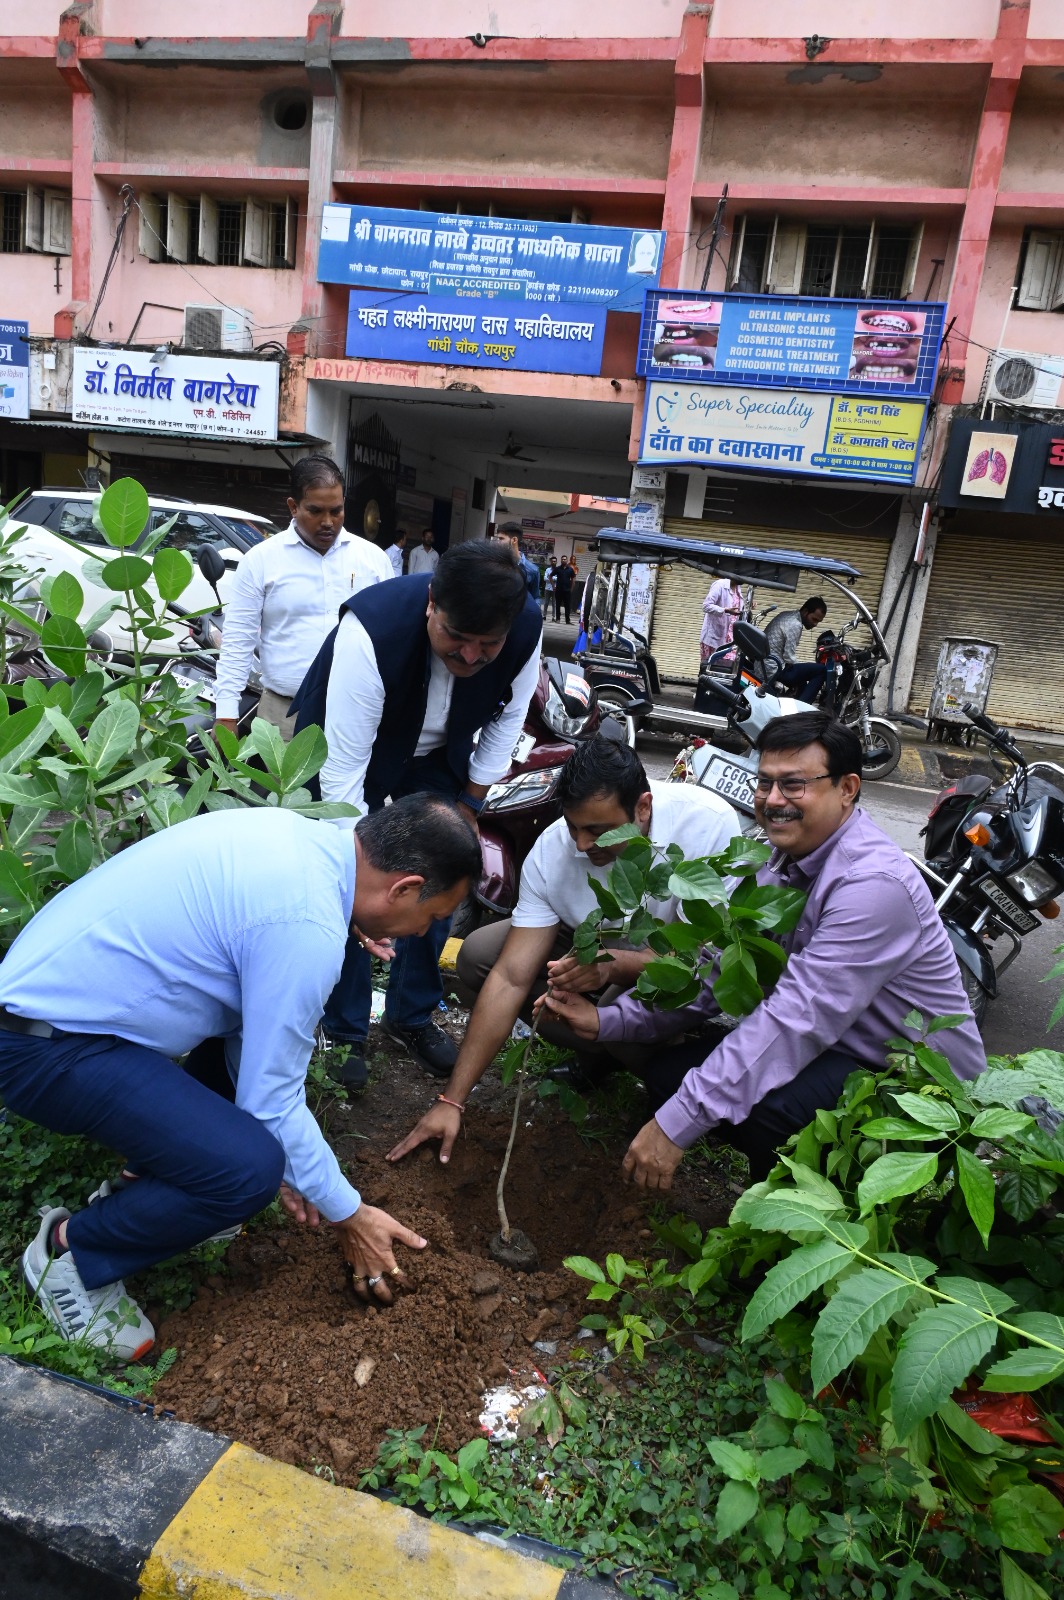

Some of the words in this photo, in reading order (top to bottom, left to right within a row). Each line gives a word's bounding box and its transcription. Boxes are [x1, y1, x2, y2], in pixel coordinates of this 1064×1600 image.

[354, 218, 372, 241] श्री
[374, 225, 432, 246] वामनराव
[434, 228, 469, 250] लाखे
[472, 234, 515, 254] उच्चतर
[518, 236, 582, 259] माध्यमिक
[584, 243, 623, 263] शाला
[436, 278, 460, 287] NAAC
[463, 280, 521, 291] ACCREDITED
[456, 289, 481, 298] Grade
[393, 305, 476, 333] लक्ष्मीनारायण
[481, 316, 508, 336] दास
[514, 313, 594, 341] महाविद्यालय
[748, 310, 781, 321] DENTAL
[784, 311, 831, 323] IMPLANTS
[740, 322, 795, 334] ULTRASONIC
[797, 325, 836, 337] SCALING
[427, 336, 451, 353] गांधी
[456, 339, 481, 358] चौक,
[484, 344, 516, 361] रायपुर
[737, 334, 783, 346] COSMETIC
[785, 337, 835, 349] DENTISTRY
[730, 346, 753, 357] ROOT
[755, 348, 783, 359] CANAL
[787, 350, 839, 363] TREATMENT
[725, 358, 785, 371] ORTHODONTIC
[788, 362, 840, 375] TREATMENT
[84, 359, 108, 394] डॉ.
[113, 363, 175, 400] निर्मल
[183, 372, 260, 408] बागरेचा
[687, 392, 733, 417] Super
[735, 395, 814, 429] Speciality
[838, 401, 852, 414] डॉ.
[856, 404, 878, 417] वृन्दा
[880, 404, 901, 417] सिंह
[688, 436, 714, 455] का
[719, 438, 805, 462] दवाखाना
[833, 432, 846, 445] डॉ.
[850, 436, 889, 449] कामाक्षी
[892, 438, 916, 451] पटेल
[354, 443, 398, 471] MAHANT
[723, 765, 749, 785] CG0
